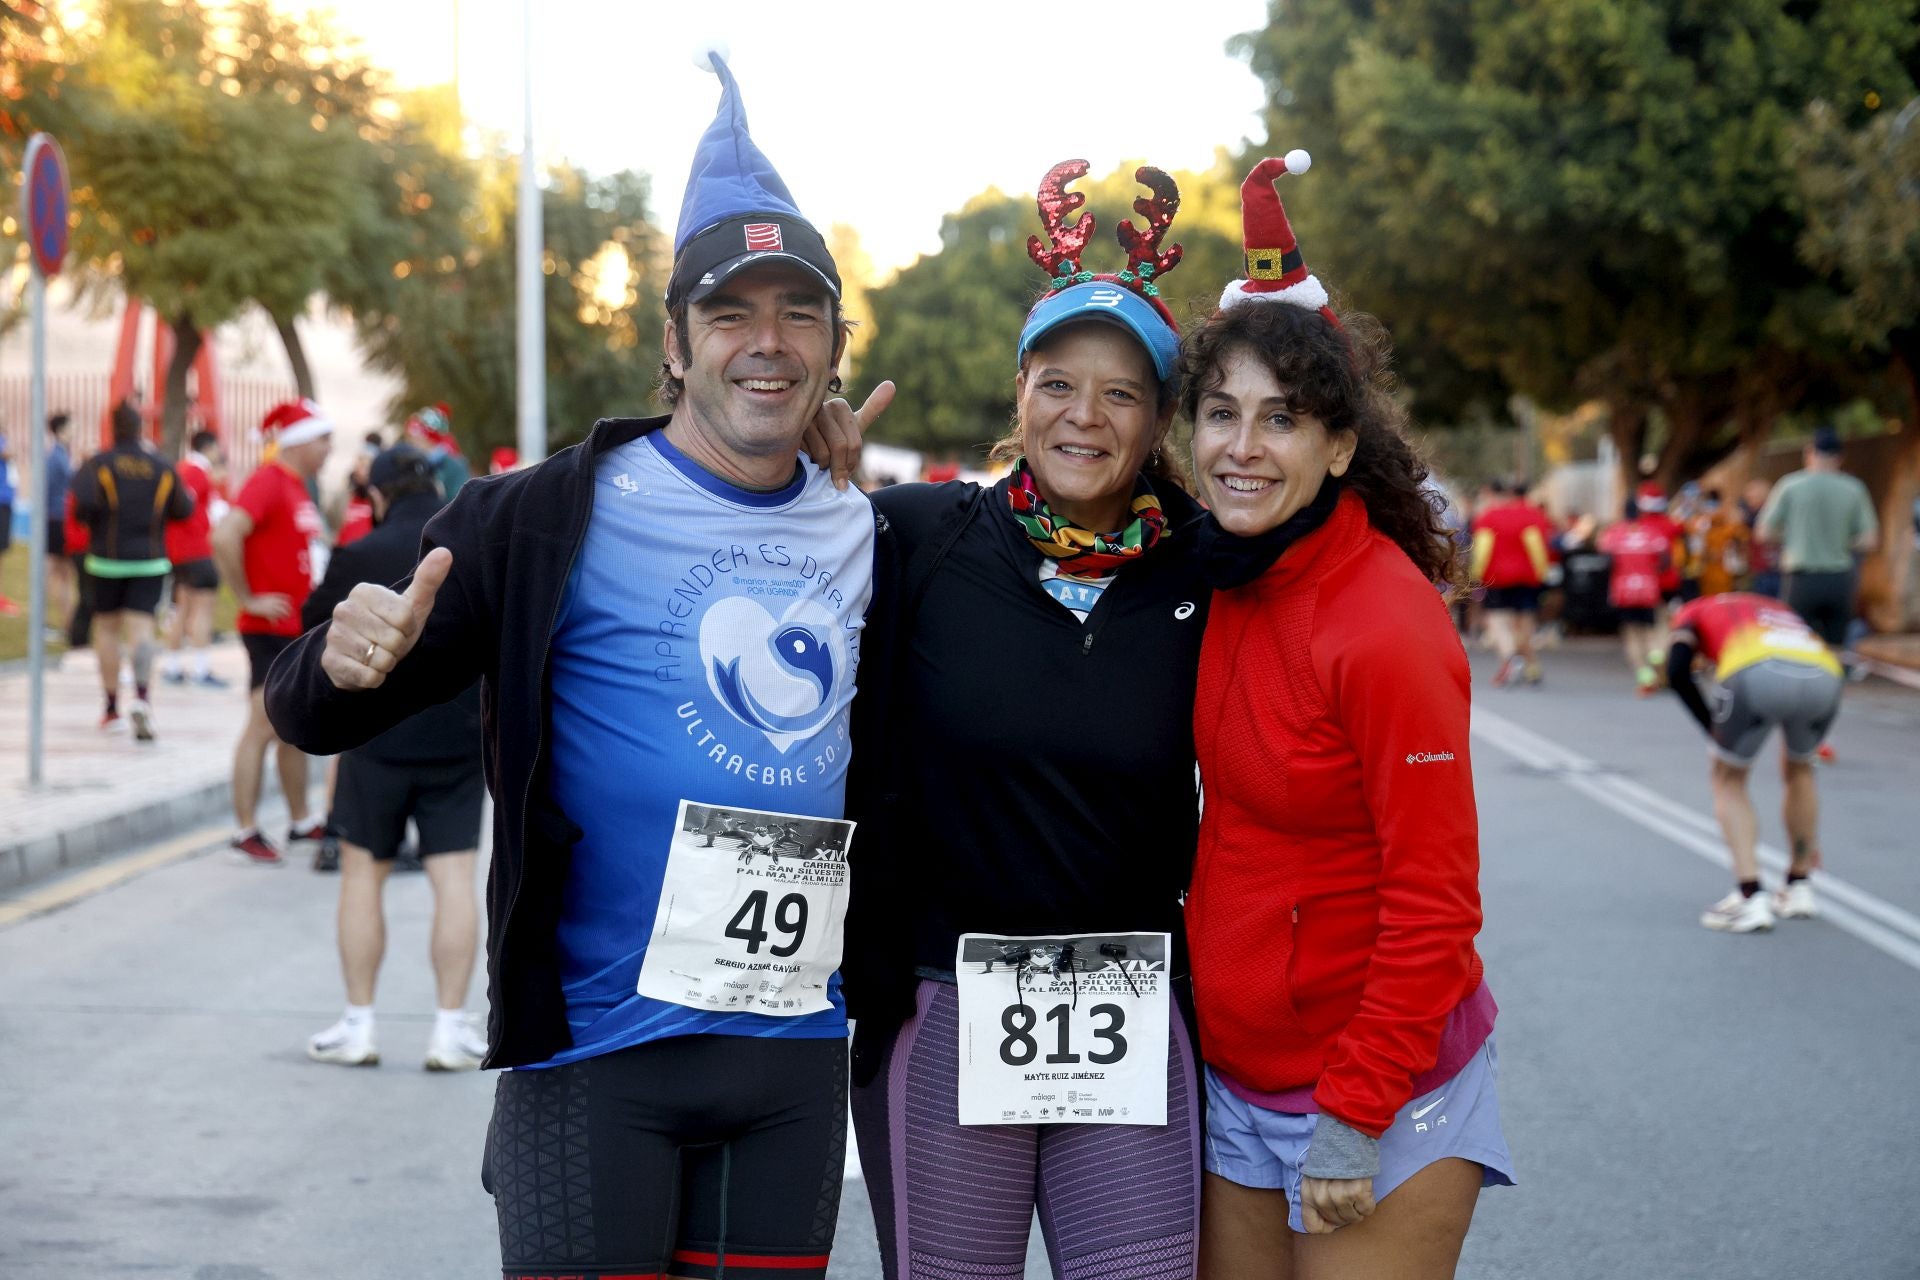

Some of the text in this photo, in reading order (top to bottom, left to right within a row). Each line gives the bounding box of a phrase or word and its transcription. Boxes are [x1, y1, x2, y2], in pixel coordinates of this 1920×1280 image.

[655, 545, 749, 681] APRENDER
[758, 544, 791, 567] ES
[800, 555, 843, 608] DAR
[677, 701, 807, 786] ULTRAEBRE
[1415, 751, 1455, 763] Columbia
[768, 864, 845, 877] SAN SILVESTRE
[803, 861, 846, 870] CARRERA
[736, 867, 844, 883] PALMA PALMILLA
[725, 889, 808, 957] 49
[714, 958, 746, 970] SERGIO
[1100, 960, 1164, 972] XIV
[1087, 972, 1158, 980] CARRERA
[1000, 1003, 1128, 1066] 813
[1051, 1072, 1069, 1080] RUIZ
[1070, 1071, 1105, 1080] JIMÉNEZ
[1415, 1115, 1447, 1133] AIR
